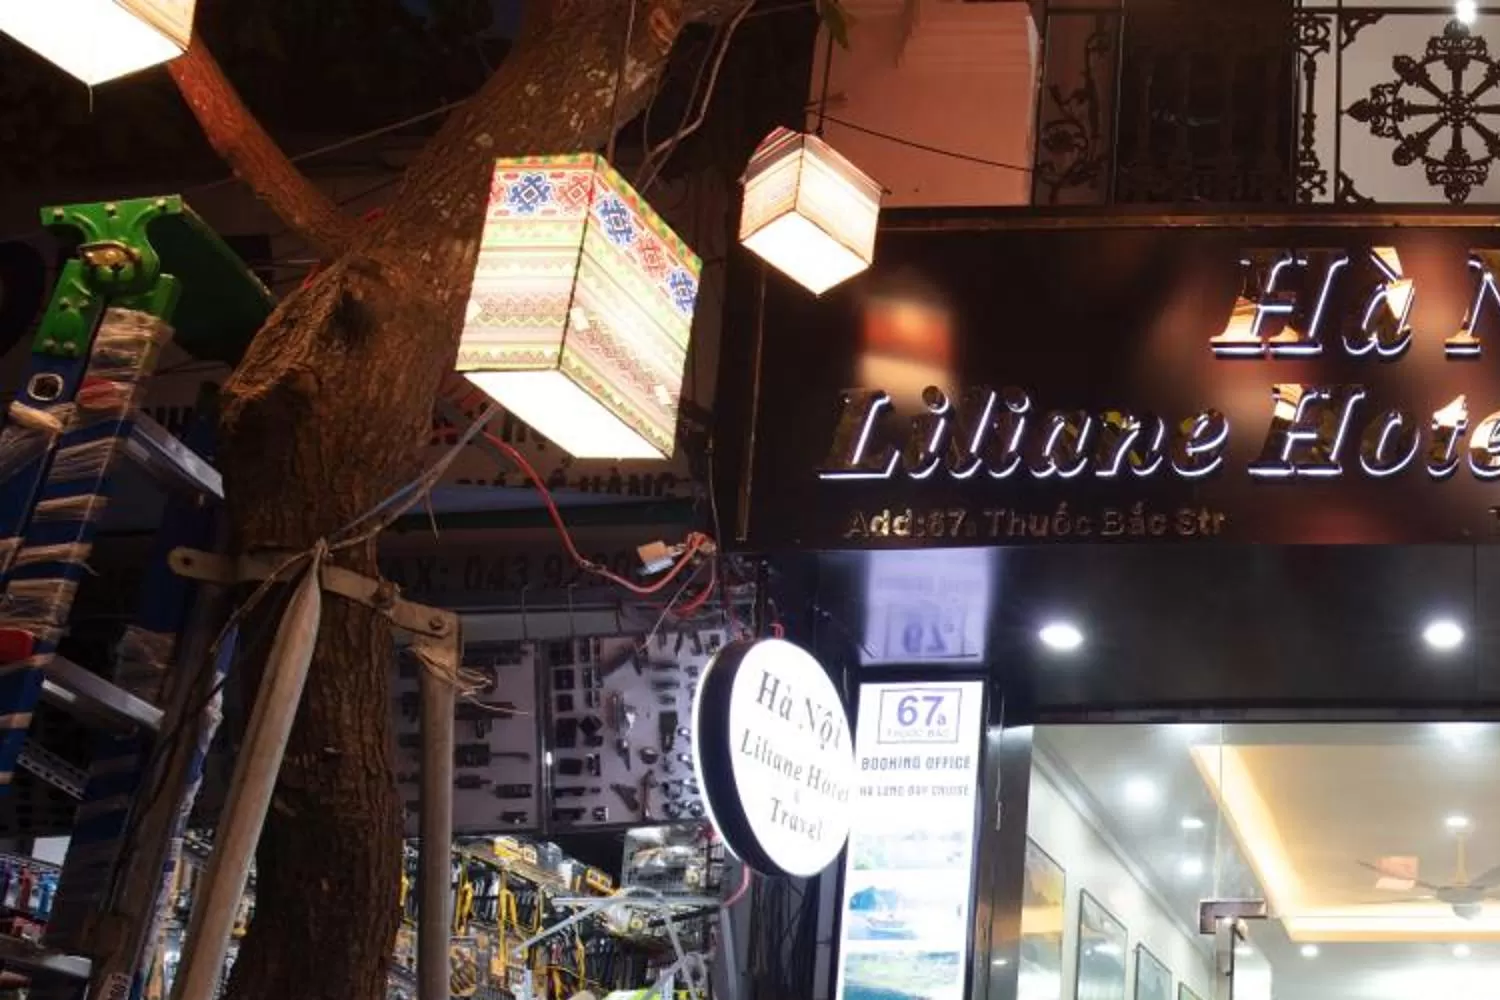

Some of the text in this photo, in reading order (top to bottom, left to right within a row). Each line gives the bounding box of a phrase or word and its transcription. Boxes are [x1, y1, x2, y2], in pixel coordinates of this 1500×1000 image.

[1211, 246, 1414, 357] Hà
[819, 385, 1229, 481] Liliane
[984, 501, 1092, 538] Thuốc
[1100, 501, 1168, 538] Bắc
[1174, 506, 1226, 538] Str
[755, 669, 844, 751] Hà Nội
[897, 695, 946, 727] 67a
[741, 728, 850, 803] Liliane Hotel
[860, 755, 971, 772] BOOKING OFFICE
[769, 796, 824, 842] Travel
